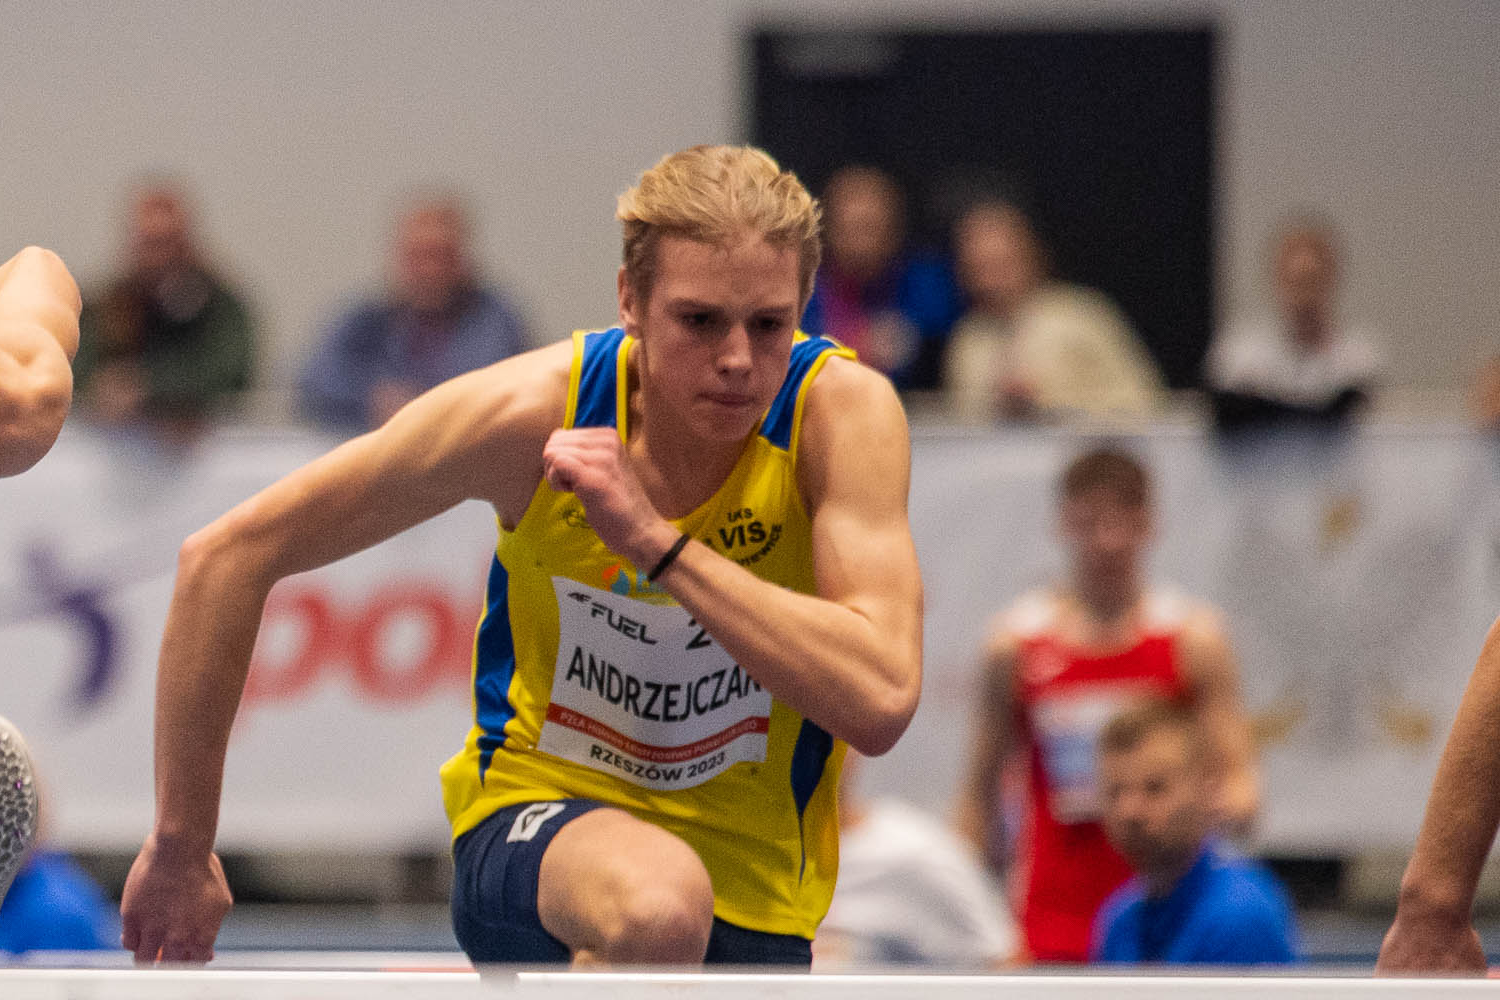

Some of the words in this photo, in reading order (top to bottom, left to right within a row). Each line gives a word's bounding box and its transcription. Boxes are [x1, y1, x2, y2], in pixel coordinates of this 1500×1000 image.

[718, 521, 766, 550] VIS
[590, 744, 683, 782] RZESZÓW
[687, 751, 726, 778] 2023
